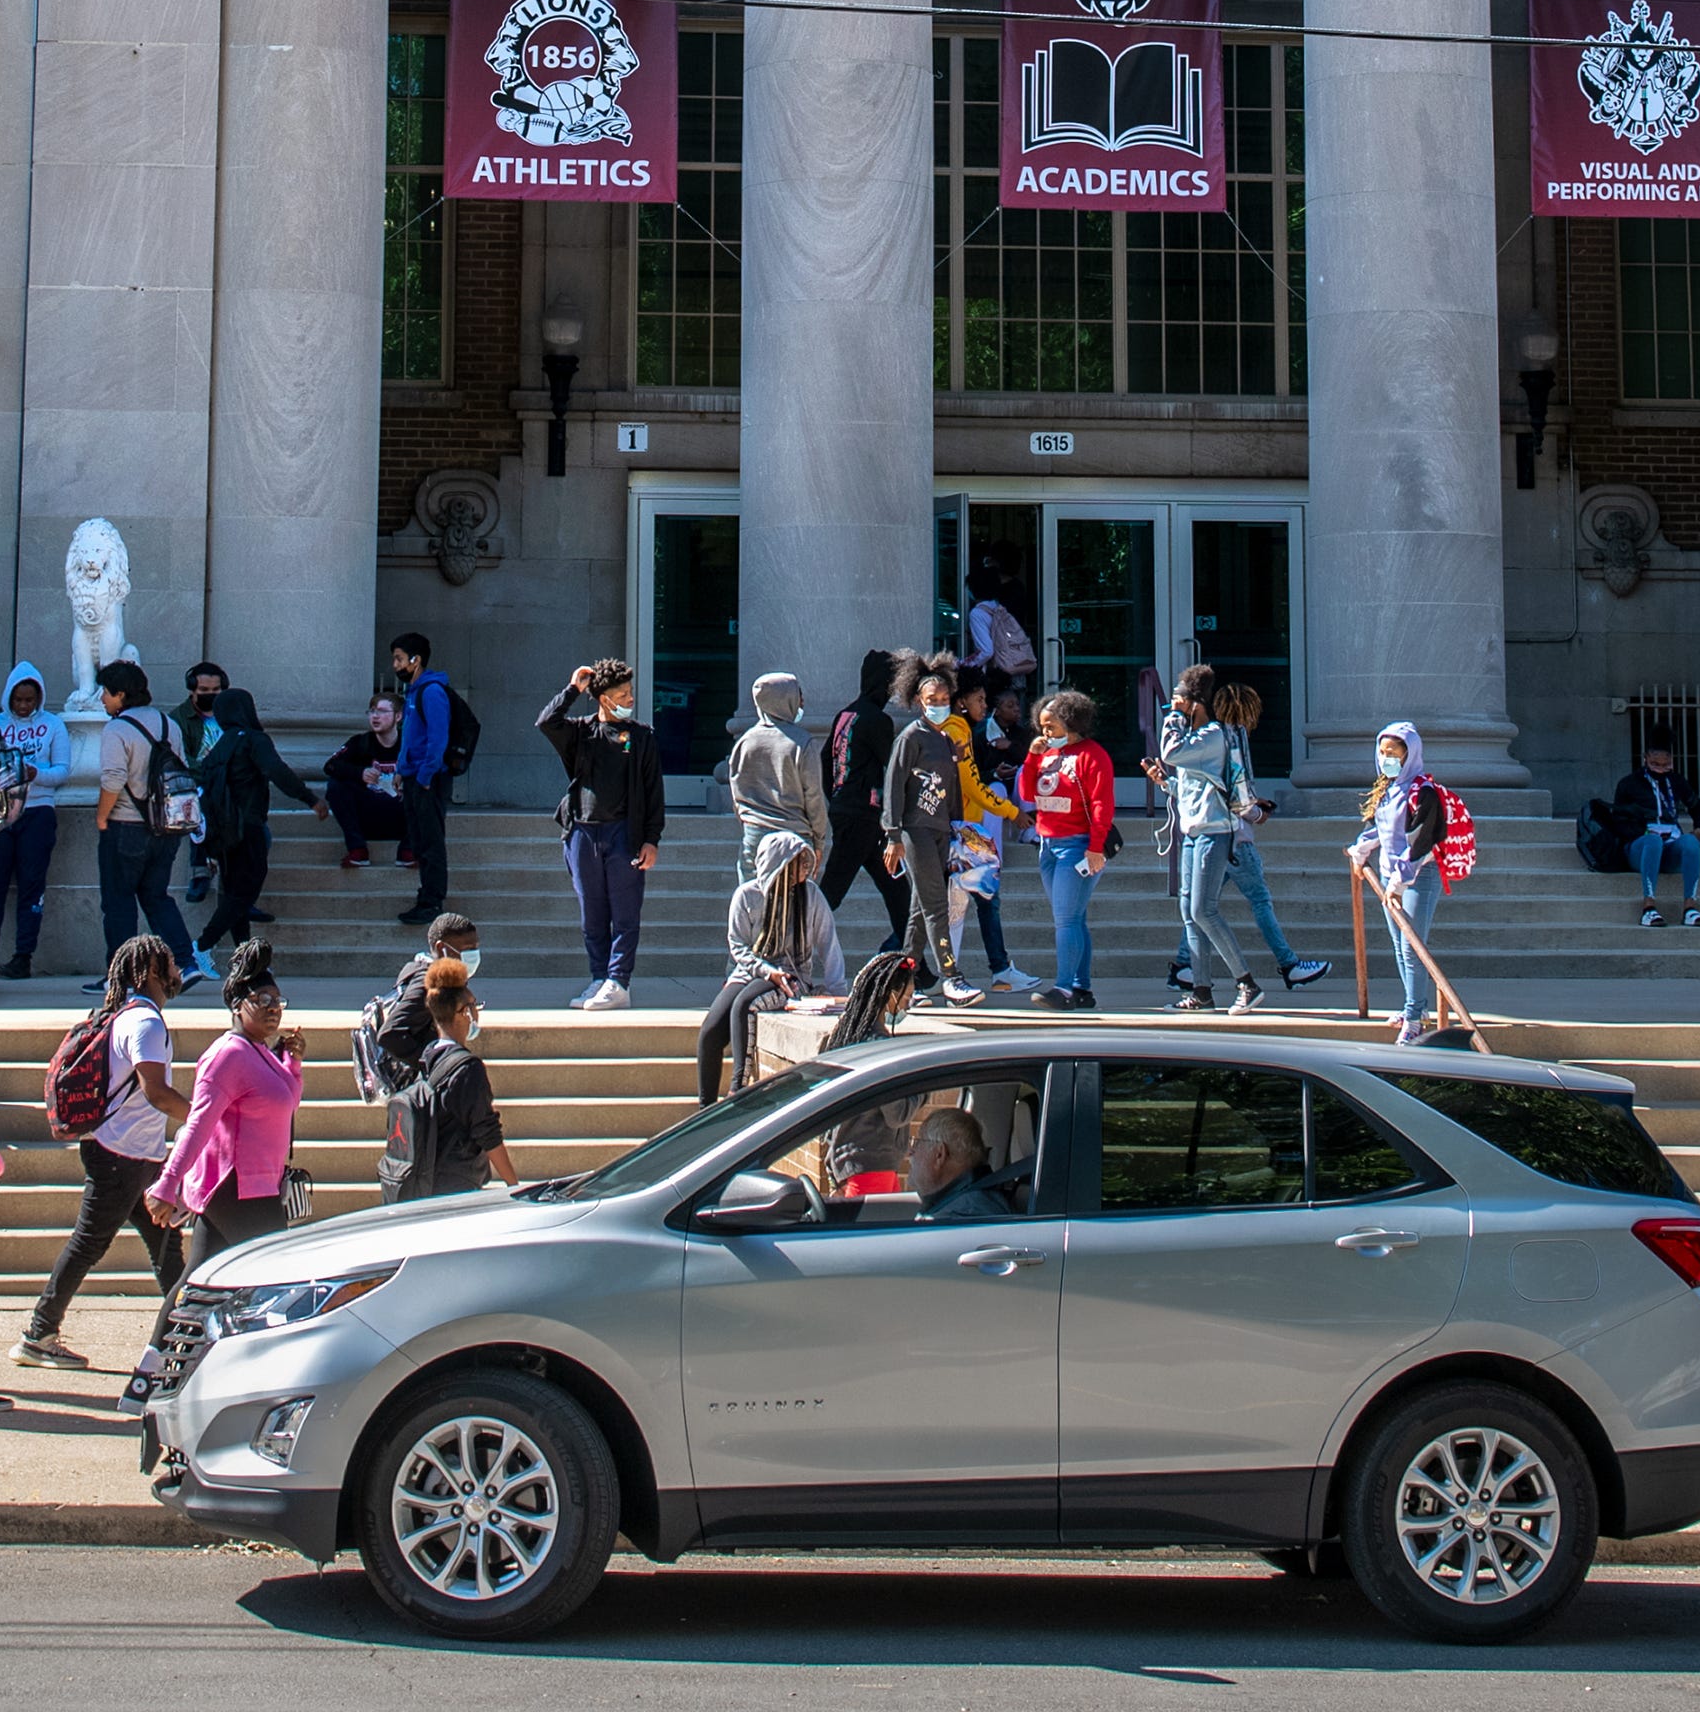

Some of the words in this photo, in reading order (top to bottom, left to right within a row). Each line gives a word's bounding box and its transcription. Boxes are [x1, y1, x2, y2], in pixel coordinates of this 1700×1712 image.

[528, 45, 596, 70] 1856
[472, 156, 651, 187] ATHLETICS
[1016, 166, 1210, 197] ACADEMICS
[1579, 162, 1654, 181] VISUAL
[1547, 183, 1682, 203] PERFORMING
[629, 429, 636, 449] 1
[1036, 435, 1069, 451] 1615
[3, 724, 48, 745] Aero
[708, 1399, 824, 1412] EQUINOX
